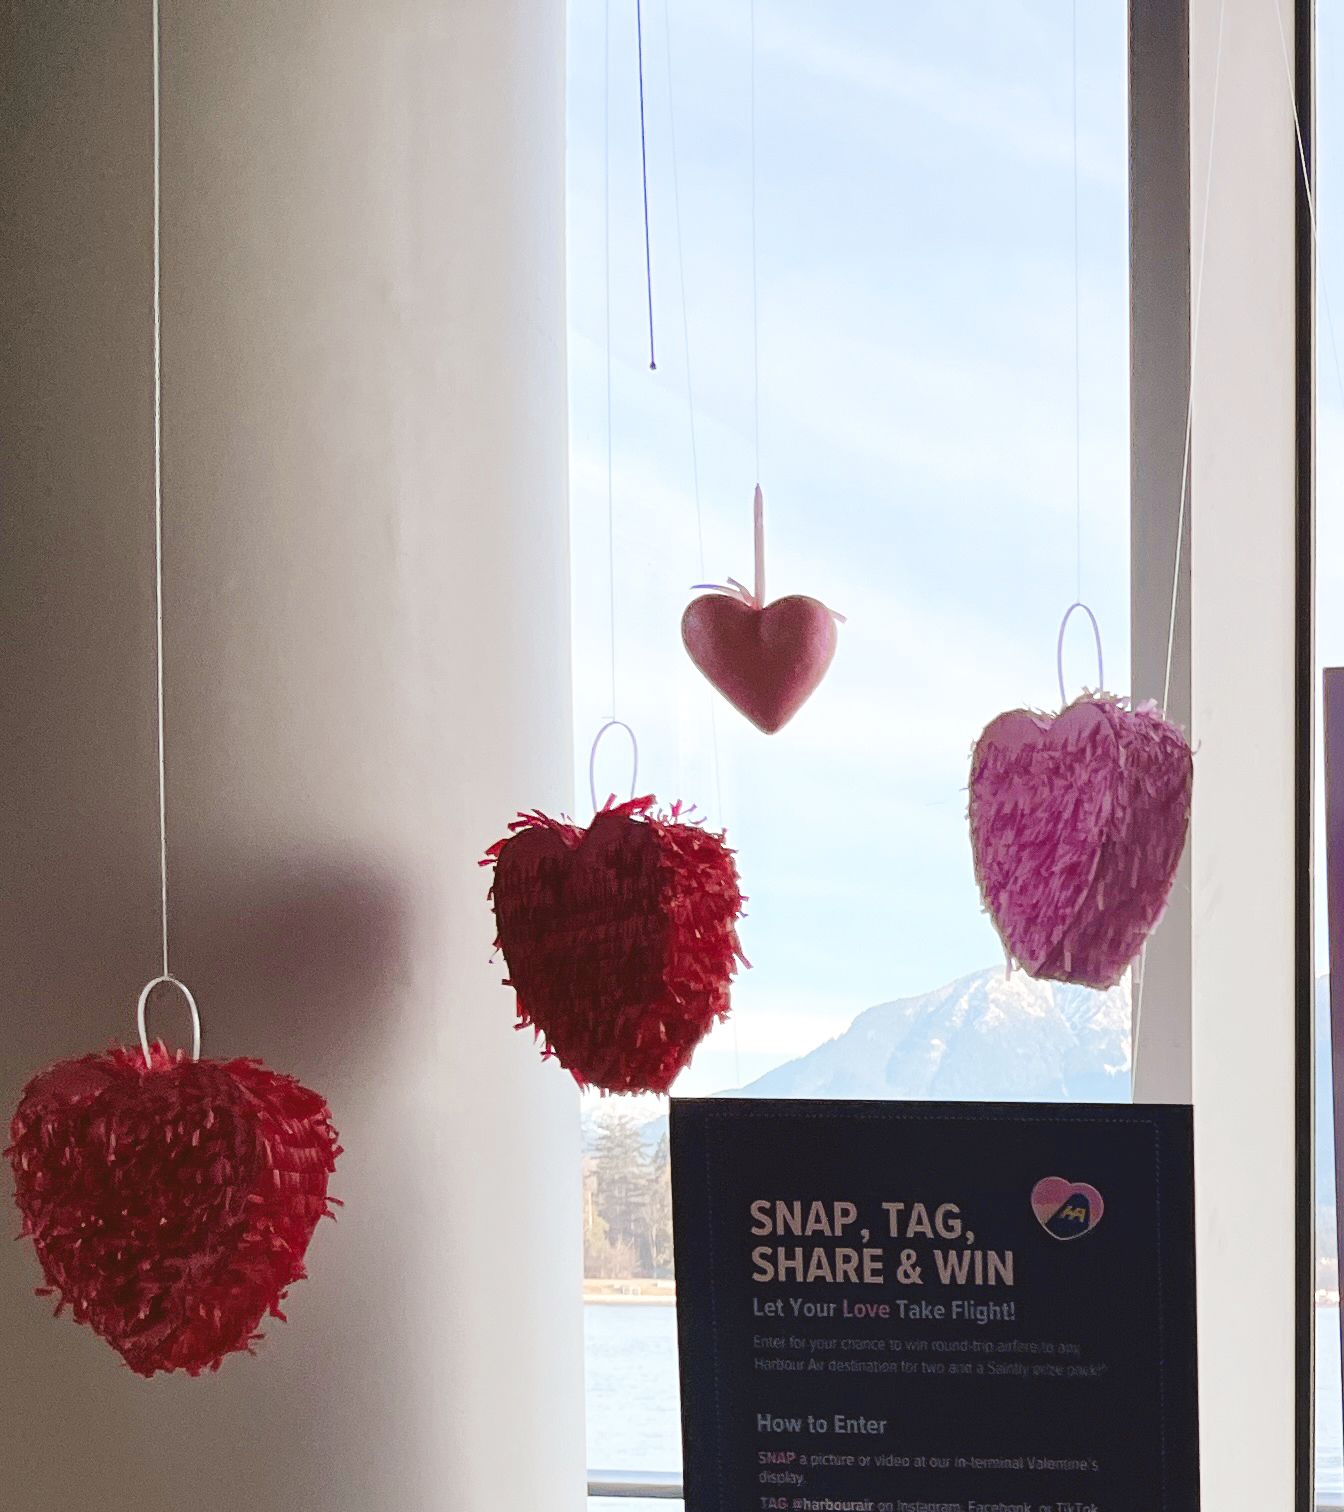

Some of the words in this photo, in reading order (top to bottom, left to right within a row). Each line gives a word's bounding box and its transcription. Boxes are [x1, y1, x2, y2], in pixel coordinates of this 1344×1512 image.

[750, 1200, 870, 1243] SNAP,
[882, 1202, 975, 1245] TAG,
[752, 1247, 884, 1284] SHARE
[896, 1248, 925, 1285] &
[933, 1249, 1015, 1286] WIN
[753, 1299, 785, 1318] Let
[790, 1299, 837, 1319] Your
[843, 1299, 891, 1319] Love
[896, 1300, 946, 1321] Take
[951, 1300, 1016, 1325] Flight!
[753, 1335, 786, 1349] Enter
[789, 1335, 805, 1350] for
[809, 1338, 837, 1353] your
[841, 1336, 886, 1351] chance
[890, 1338, 902, 1351] to
[906, 1339, 928, 1351] win
[754, 1358, 805, 1372] Harbour
[828, 1359, 898, 1373] destination
[901, 1360, 918, 1374] for
[921, 1361, 944, 1374] two
[757, 1413, 803, 1433] How
[808, 1415, 828, 1434] to
[834, 1414, 887, 1435] Enter
[758, 1451, 797, 1465] SNAP
[799, 1455, 808, 1466] a
[810, 1453, 855, 1468] picture
[858, 1456, 871, 1467] or
[874, 1454, 910, 1467] video
[914, 1455, 926, 1467] at
[929, 1457, 951, 1468] our
[759, 1470, 806, 1487] display.
[760, 1497, 789, 1510] TAG
[792, 1497, 875, 1512] @harbourair
[878, 1501, 893, 1512] on
